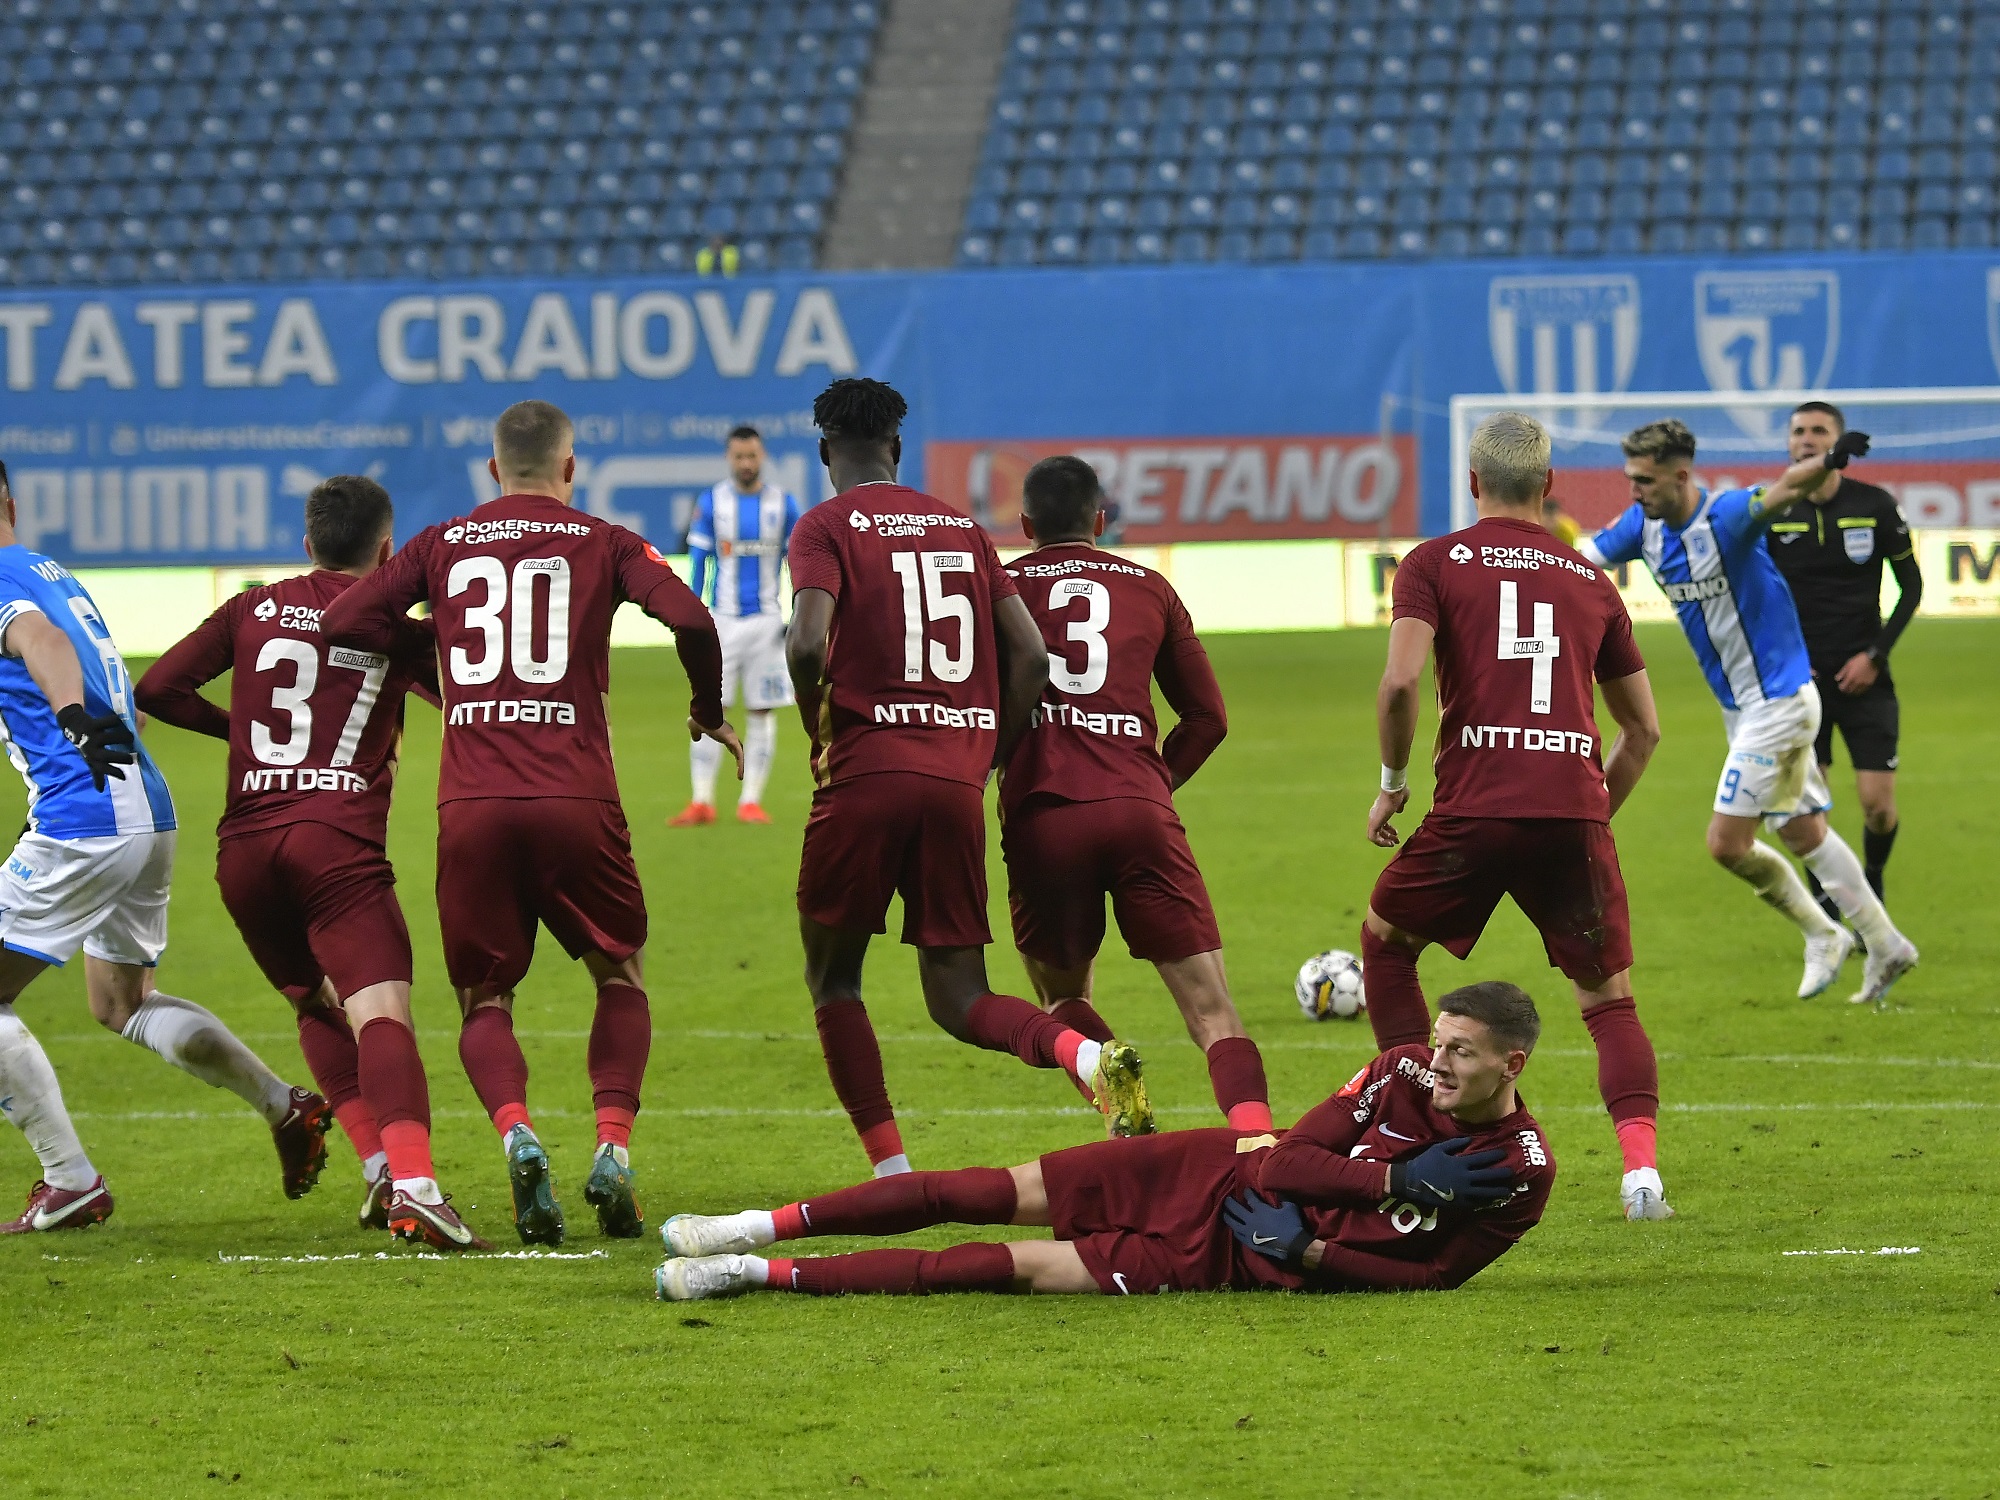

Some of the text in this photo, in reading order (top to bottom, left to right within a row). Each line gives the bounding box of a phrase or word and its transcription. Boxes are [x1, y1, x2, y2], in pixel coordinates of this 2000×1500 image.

[378, 289, 858, 384] CRAIOVA
[12, 465, 271, 553] PUMA
[873, 513, 975, 529] POKERSTARS
[465, 519, 591, 537] POKERSTARS
[465, 530, 523, 545] CASINO
[877, 525, 926, 537] CASINO
[933, 555, 963, 567] YEBOAH
[1023, 559, 1146, 578] POKERSTARS
[1025, 565, 1083, 577] CASINO
[1481, 545, 1596, 581] POKERSTARS
[1482, 557, 1541, 571] CASINO
[447, 556, 571, 686] 30
[891, 551, 975, 683] 15
[1047, 577, 1111, 695] 3
[1497, 580, 1560, 715] 4
[1513, 641, 1544, 654] MANEA
[250, 637, 390, 767] 37
[874, 702, 931, 724] NTT
[1461, 725, 1521, 749] NTT
[241, 768, 294, 792] NTT
[1720, 768, 1742, 804] 9
[1397, 1056, 1436, 1088] RMB
[1519, 1130, 1547, 1167] RMB
